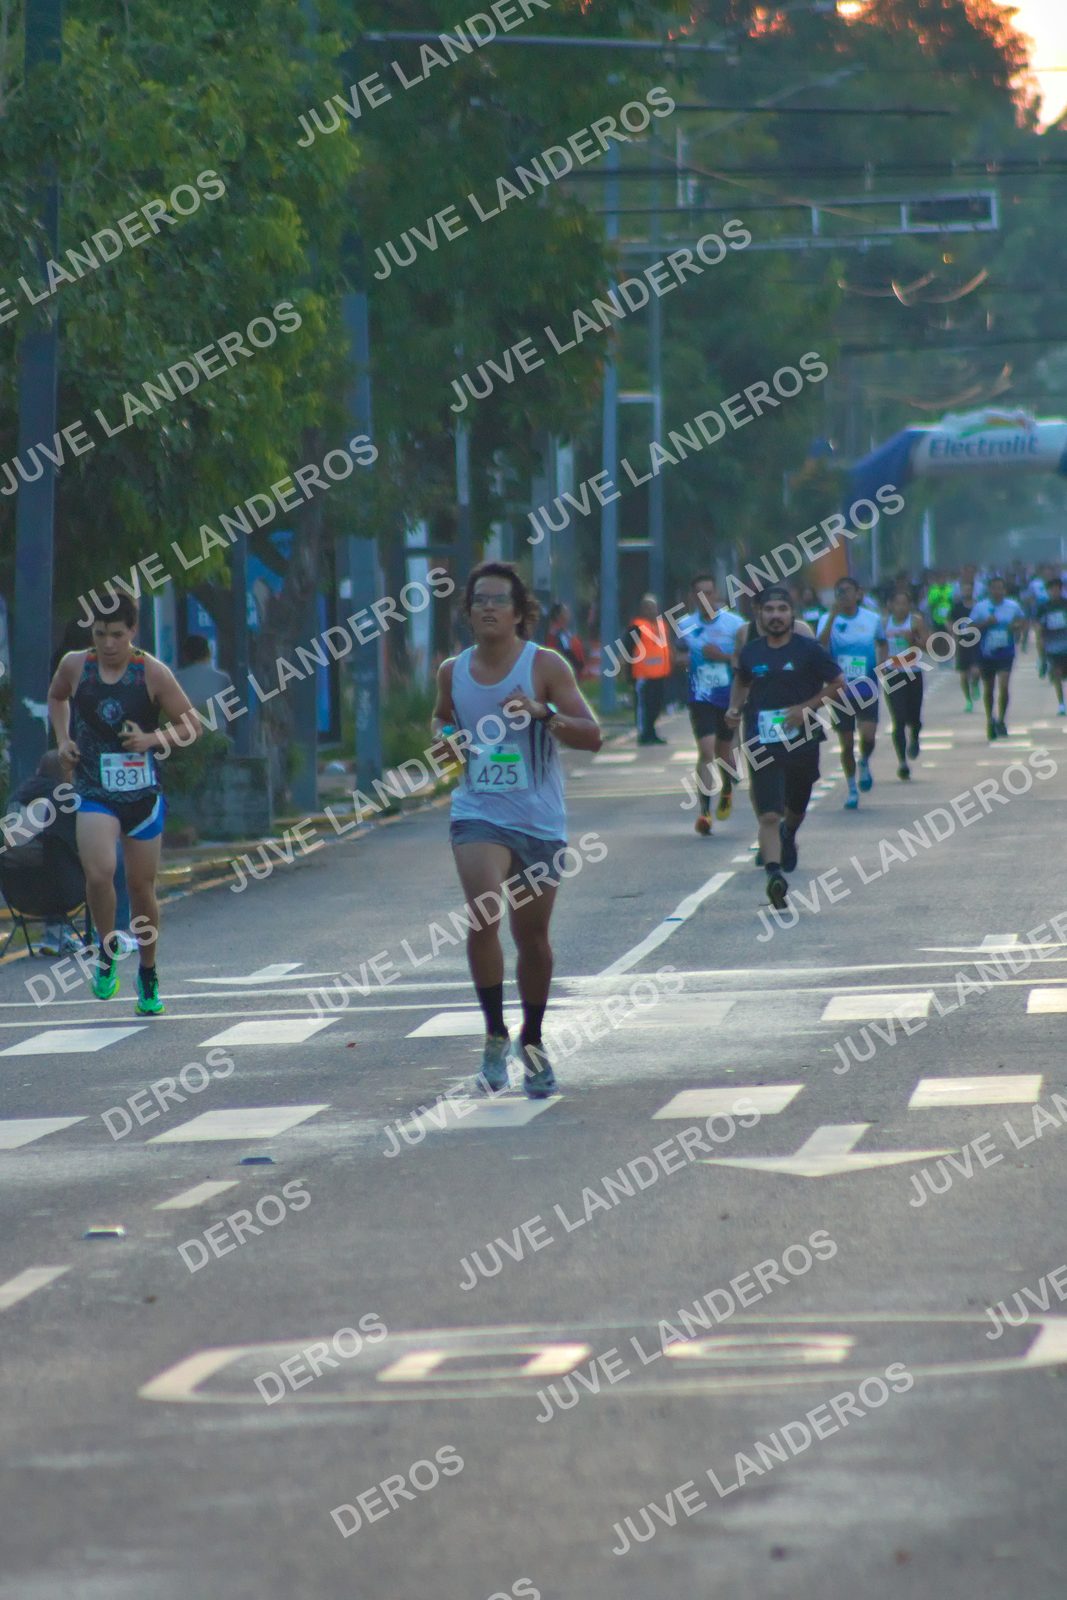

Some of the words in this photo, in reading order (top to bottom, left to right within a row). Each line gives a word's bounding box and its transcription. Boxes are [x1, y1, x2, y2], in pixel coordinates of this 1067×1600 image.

[929, 434, 1039, 459] Electrolit
[104, 767, 146, 788] 1831
[476, 764, 519, 786] 425
